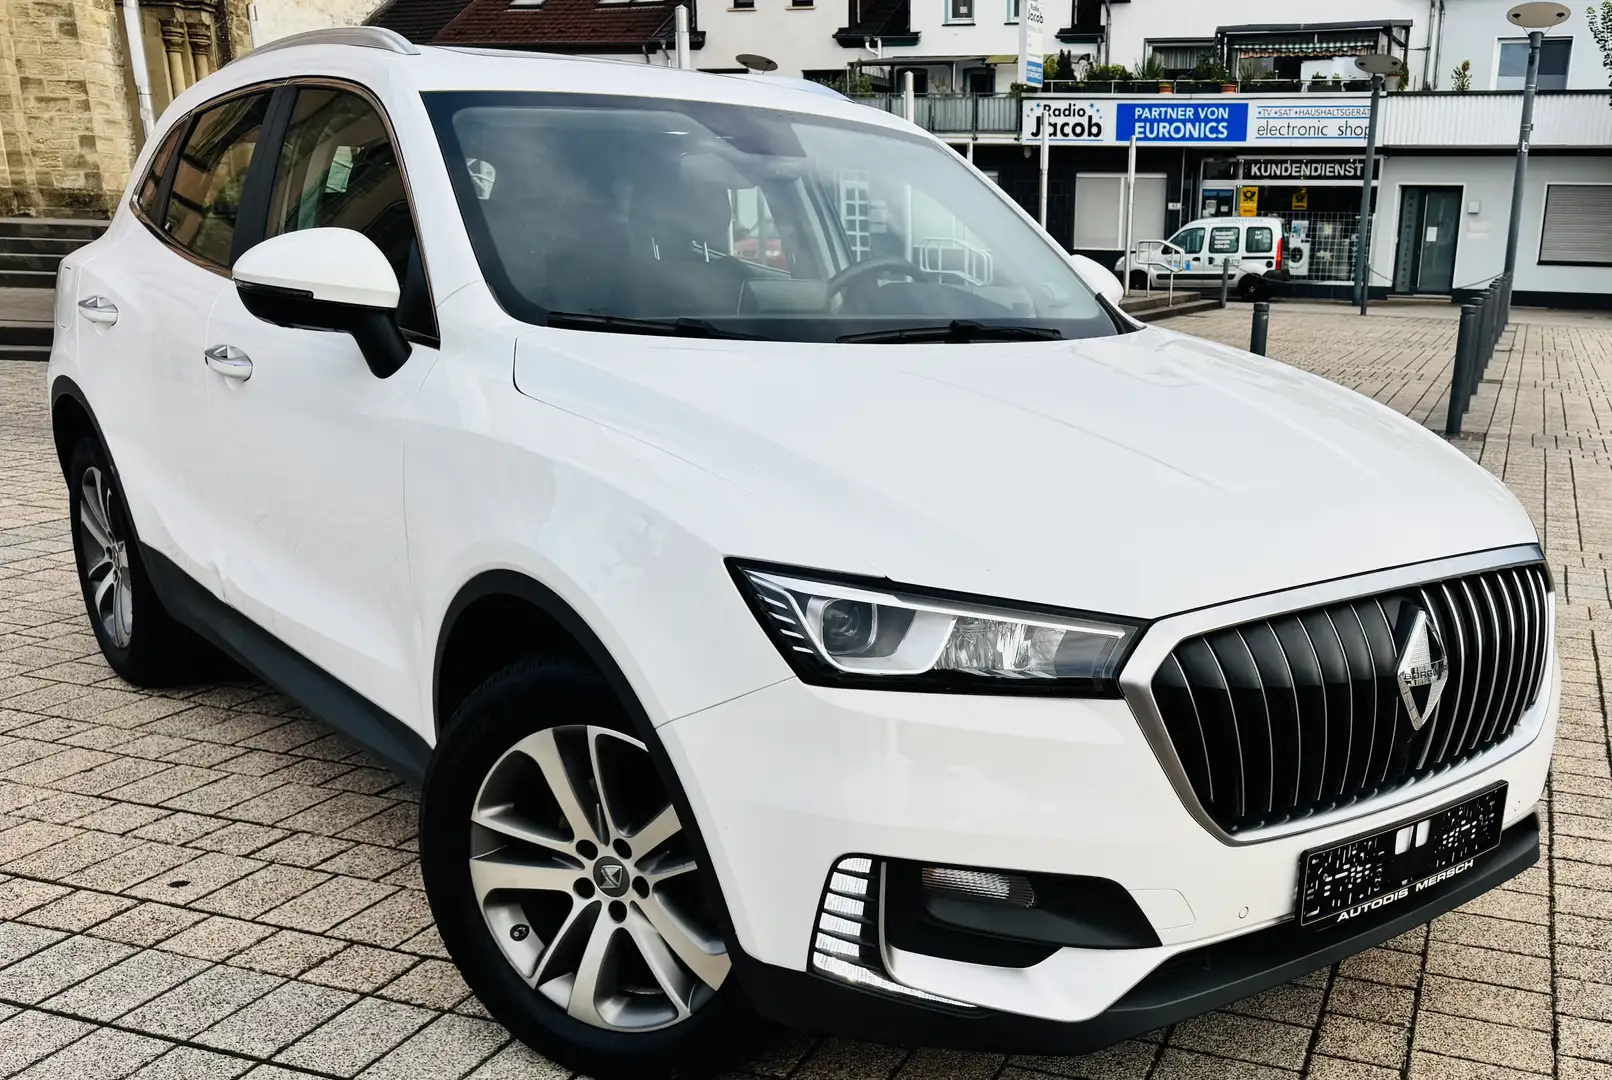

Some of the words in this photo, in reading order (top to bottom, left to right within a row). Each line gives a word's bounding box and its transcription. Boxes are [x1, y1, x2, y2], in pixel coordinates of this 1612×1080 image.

[1028, 9, 1043, 24] Jacob
[1043, 103, 1086, 118] Radio
[1134, 107, 1193, 119] PARTNER
[1198, 107, 1229, 119] VON
[1262, 108, 1273, 117] TV
[1277, 108, 1292, 117] SAT
[1031, 115, 1102, 138] Jacob
[1134, 122, 1228, 138] EURONICS
[1257, 120, 1328, 136] electronic
[1337, 120, 1369, 139] shop
[1251, 163, 1364, 176] KUNDENDIENST
[1336, 888, 1409, 922] AUTODIS
[1415, 859, 1474, 892] MERSCH
